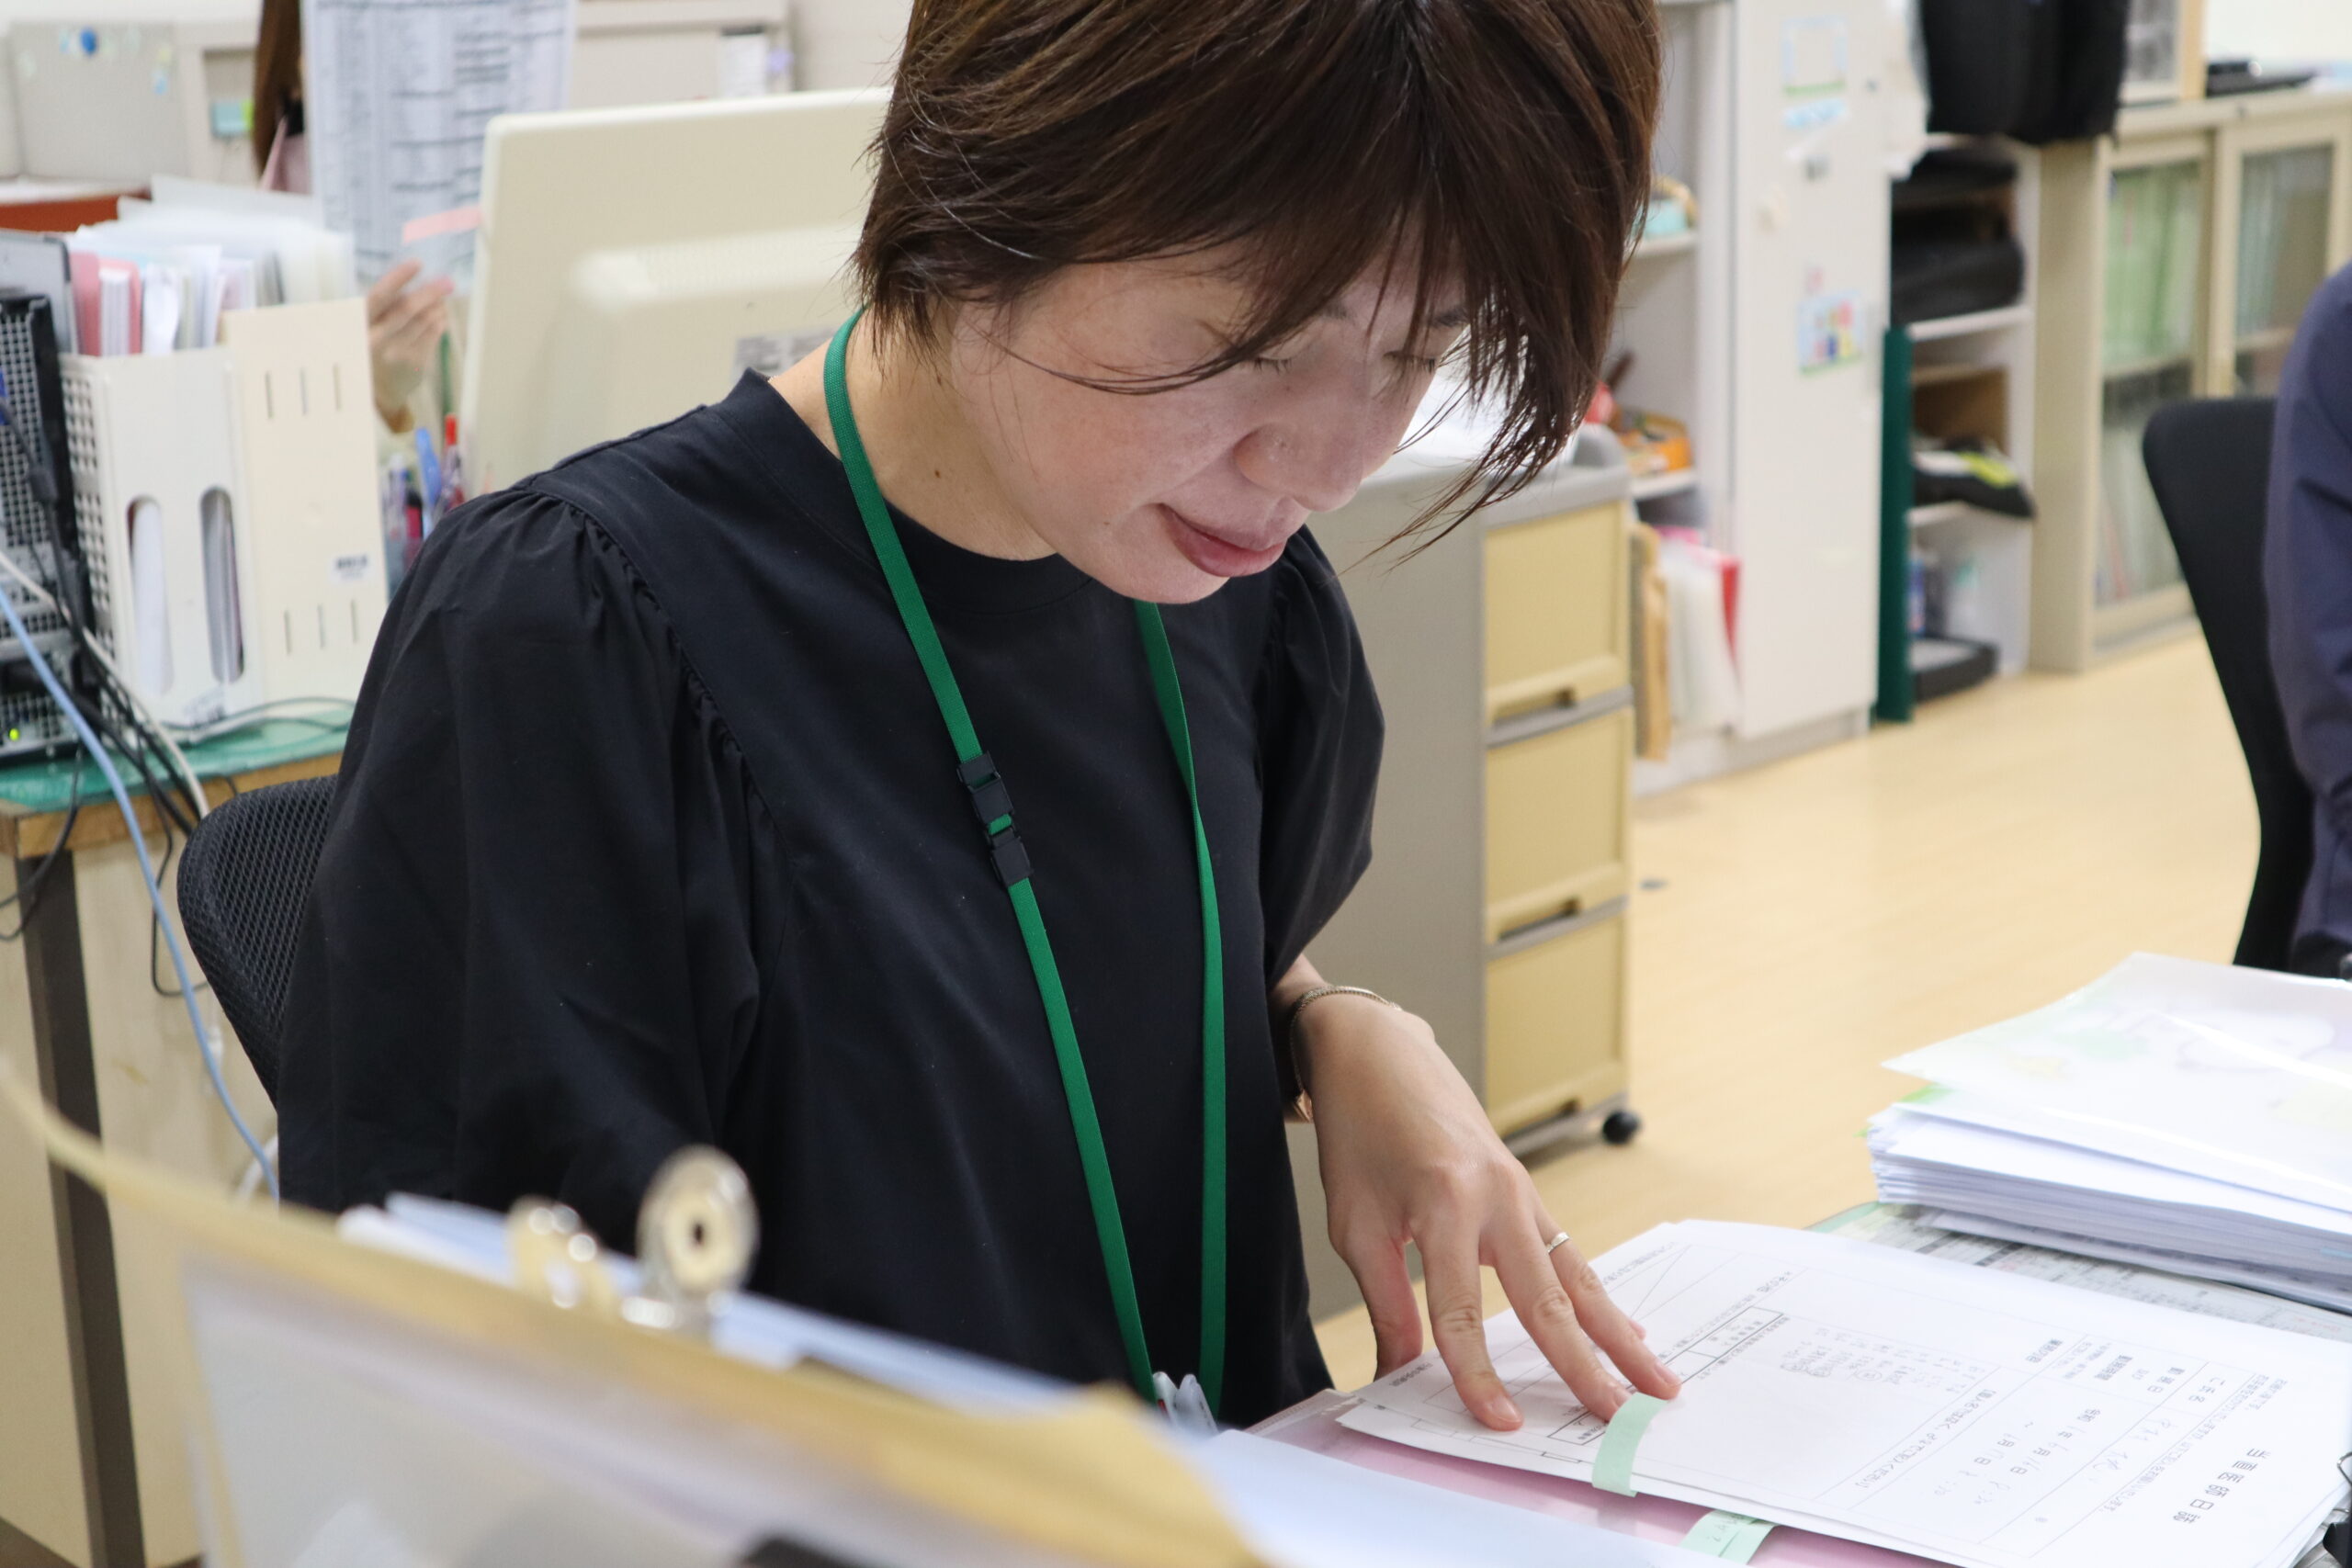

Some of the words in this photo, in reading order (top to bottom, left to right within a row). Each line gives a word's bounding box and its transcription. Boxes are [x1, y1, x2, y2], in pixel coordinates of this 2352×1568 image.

[2169, 1448, 2271, 1524] 当直医師日誌
